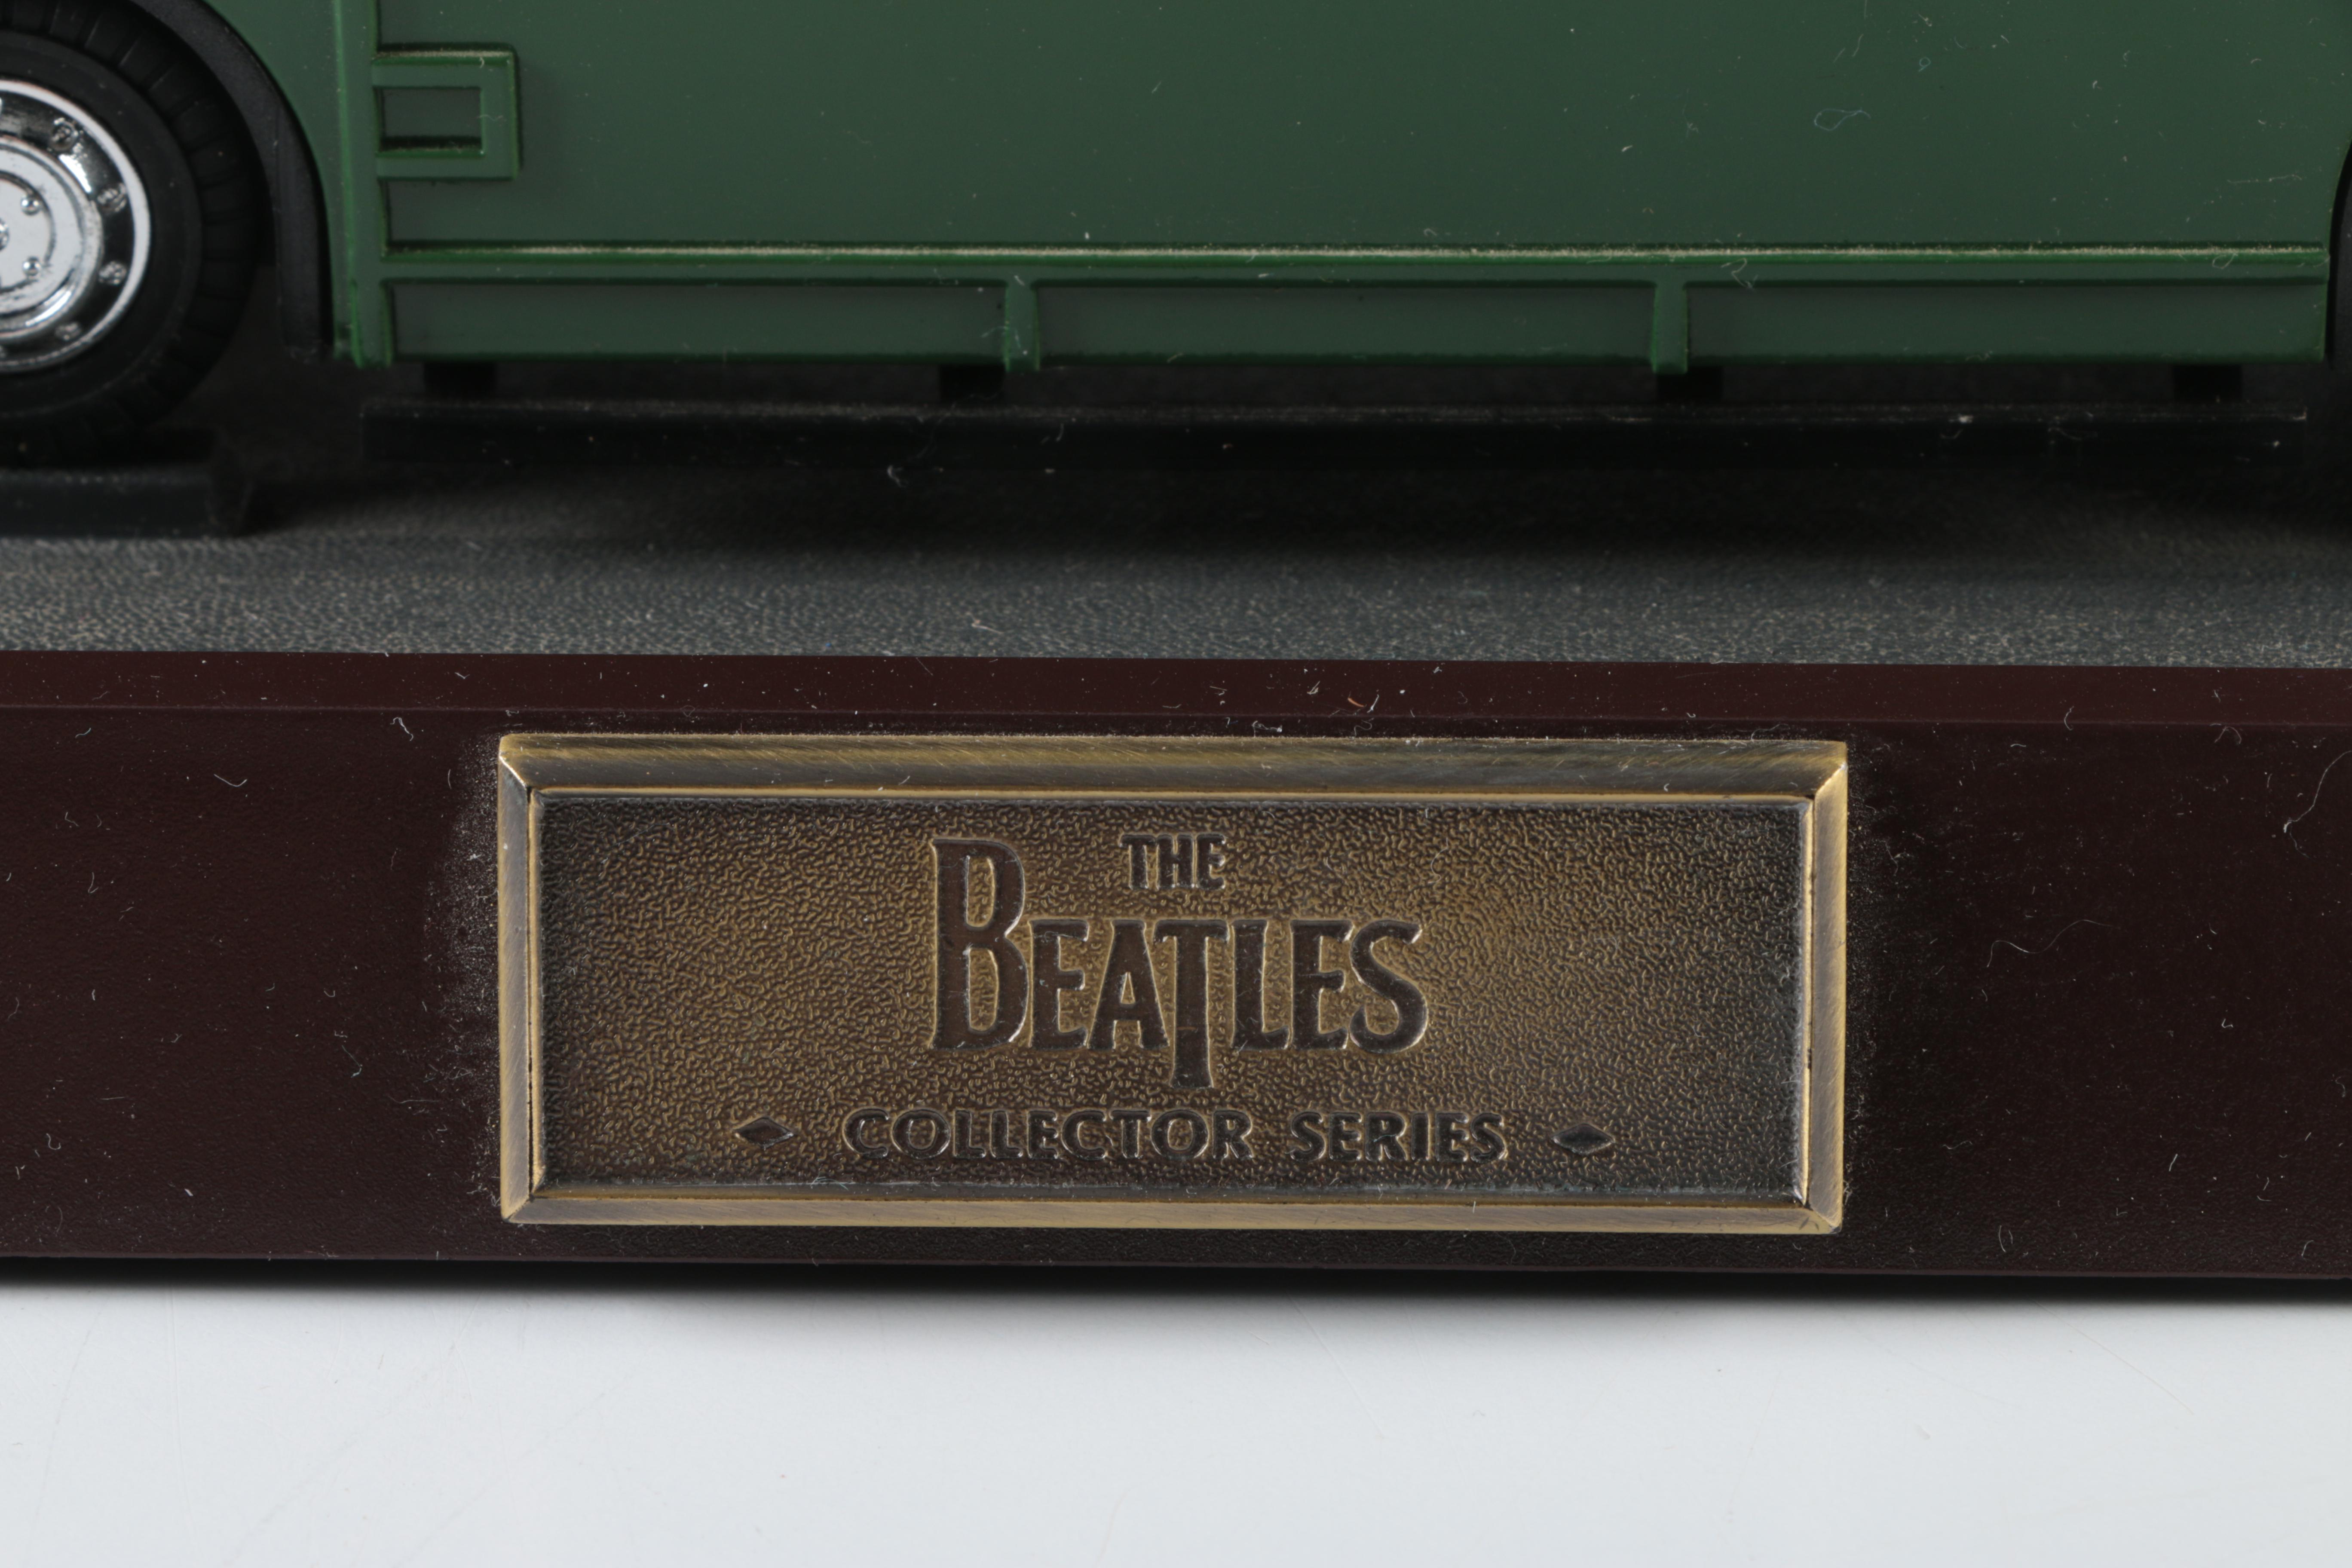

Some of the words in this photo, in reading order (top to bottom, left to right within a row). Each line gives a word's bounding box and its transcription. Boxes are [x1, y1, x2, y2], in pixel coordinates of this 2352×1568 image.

[1120, 834, 1227, 890] THE
[930, 839, 1428, 1089] BEATLES
[843, 1108, 1254, 1161] COLLECTOR
[1289, 1110, 1510, 1163] SERIES
